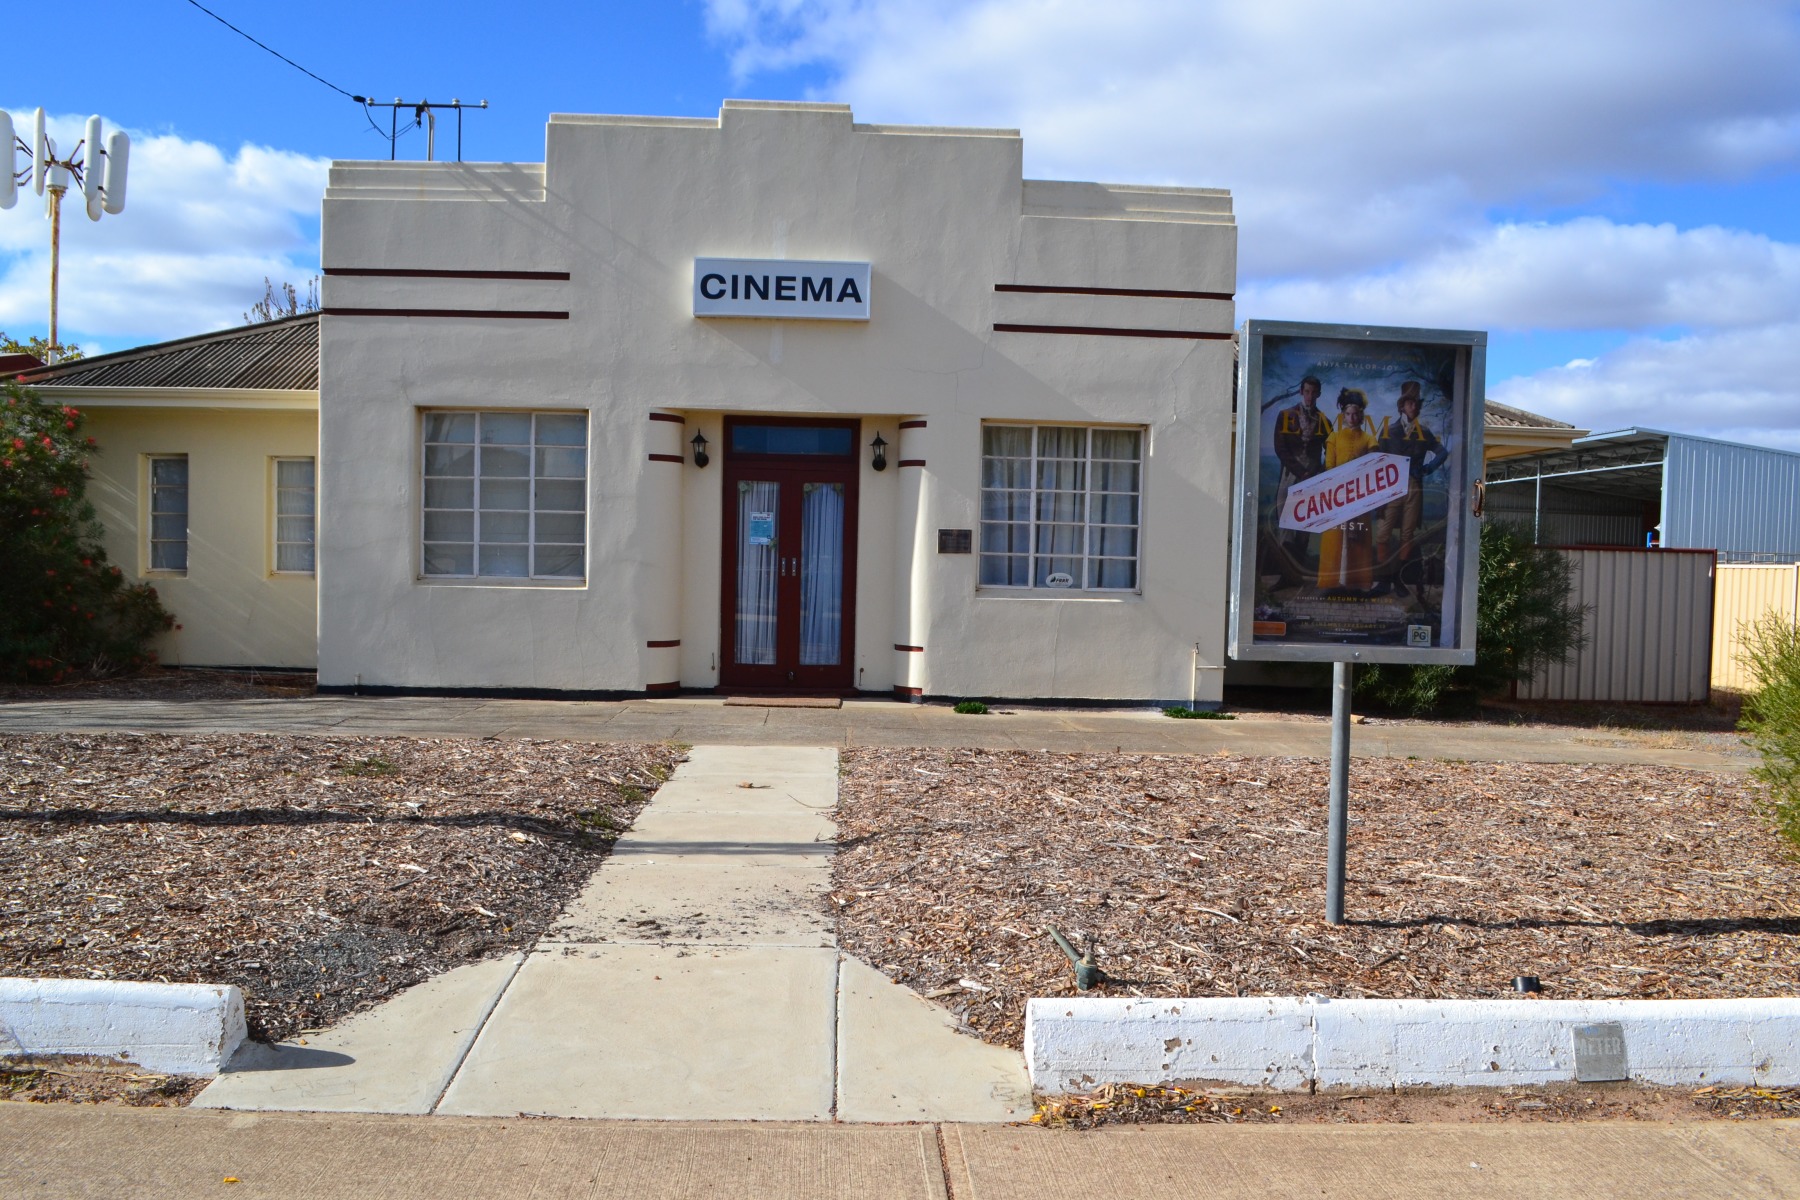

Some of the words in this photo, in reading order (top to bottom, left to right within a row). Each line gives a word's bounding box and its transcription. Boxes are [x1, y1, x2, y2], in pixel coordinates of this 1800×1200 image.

[700, 273, 862, 303] CINEMA
[1316, 360, 1340, 368] ANYA
[1343, 362, 1399, 371] TAYLOR-JOY
[1293, 463, 1400, 522] CANCELLED
[1332, 522, 1369, 531] EST.
[1413, 631, 1427, 641] PG
[1578, 1037, 1622, 1056] METER
